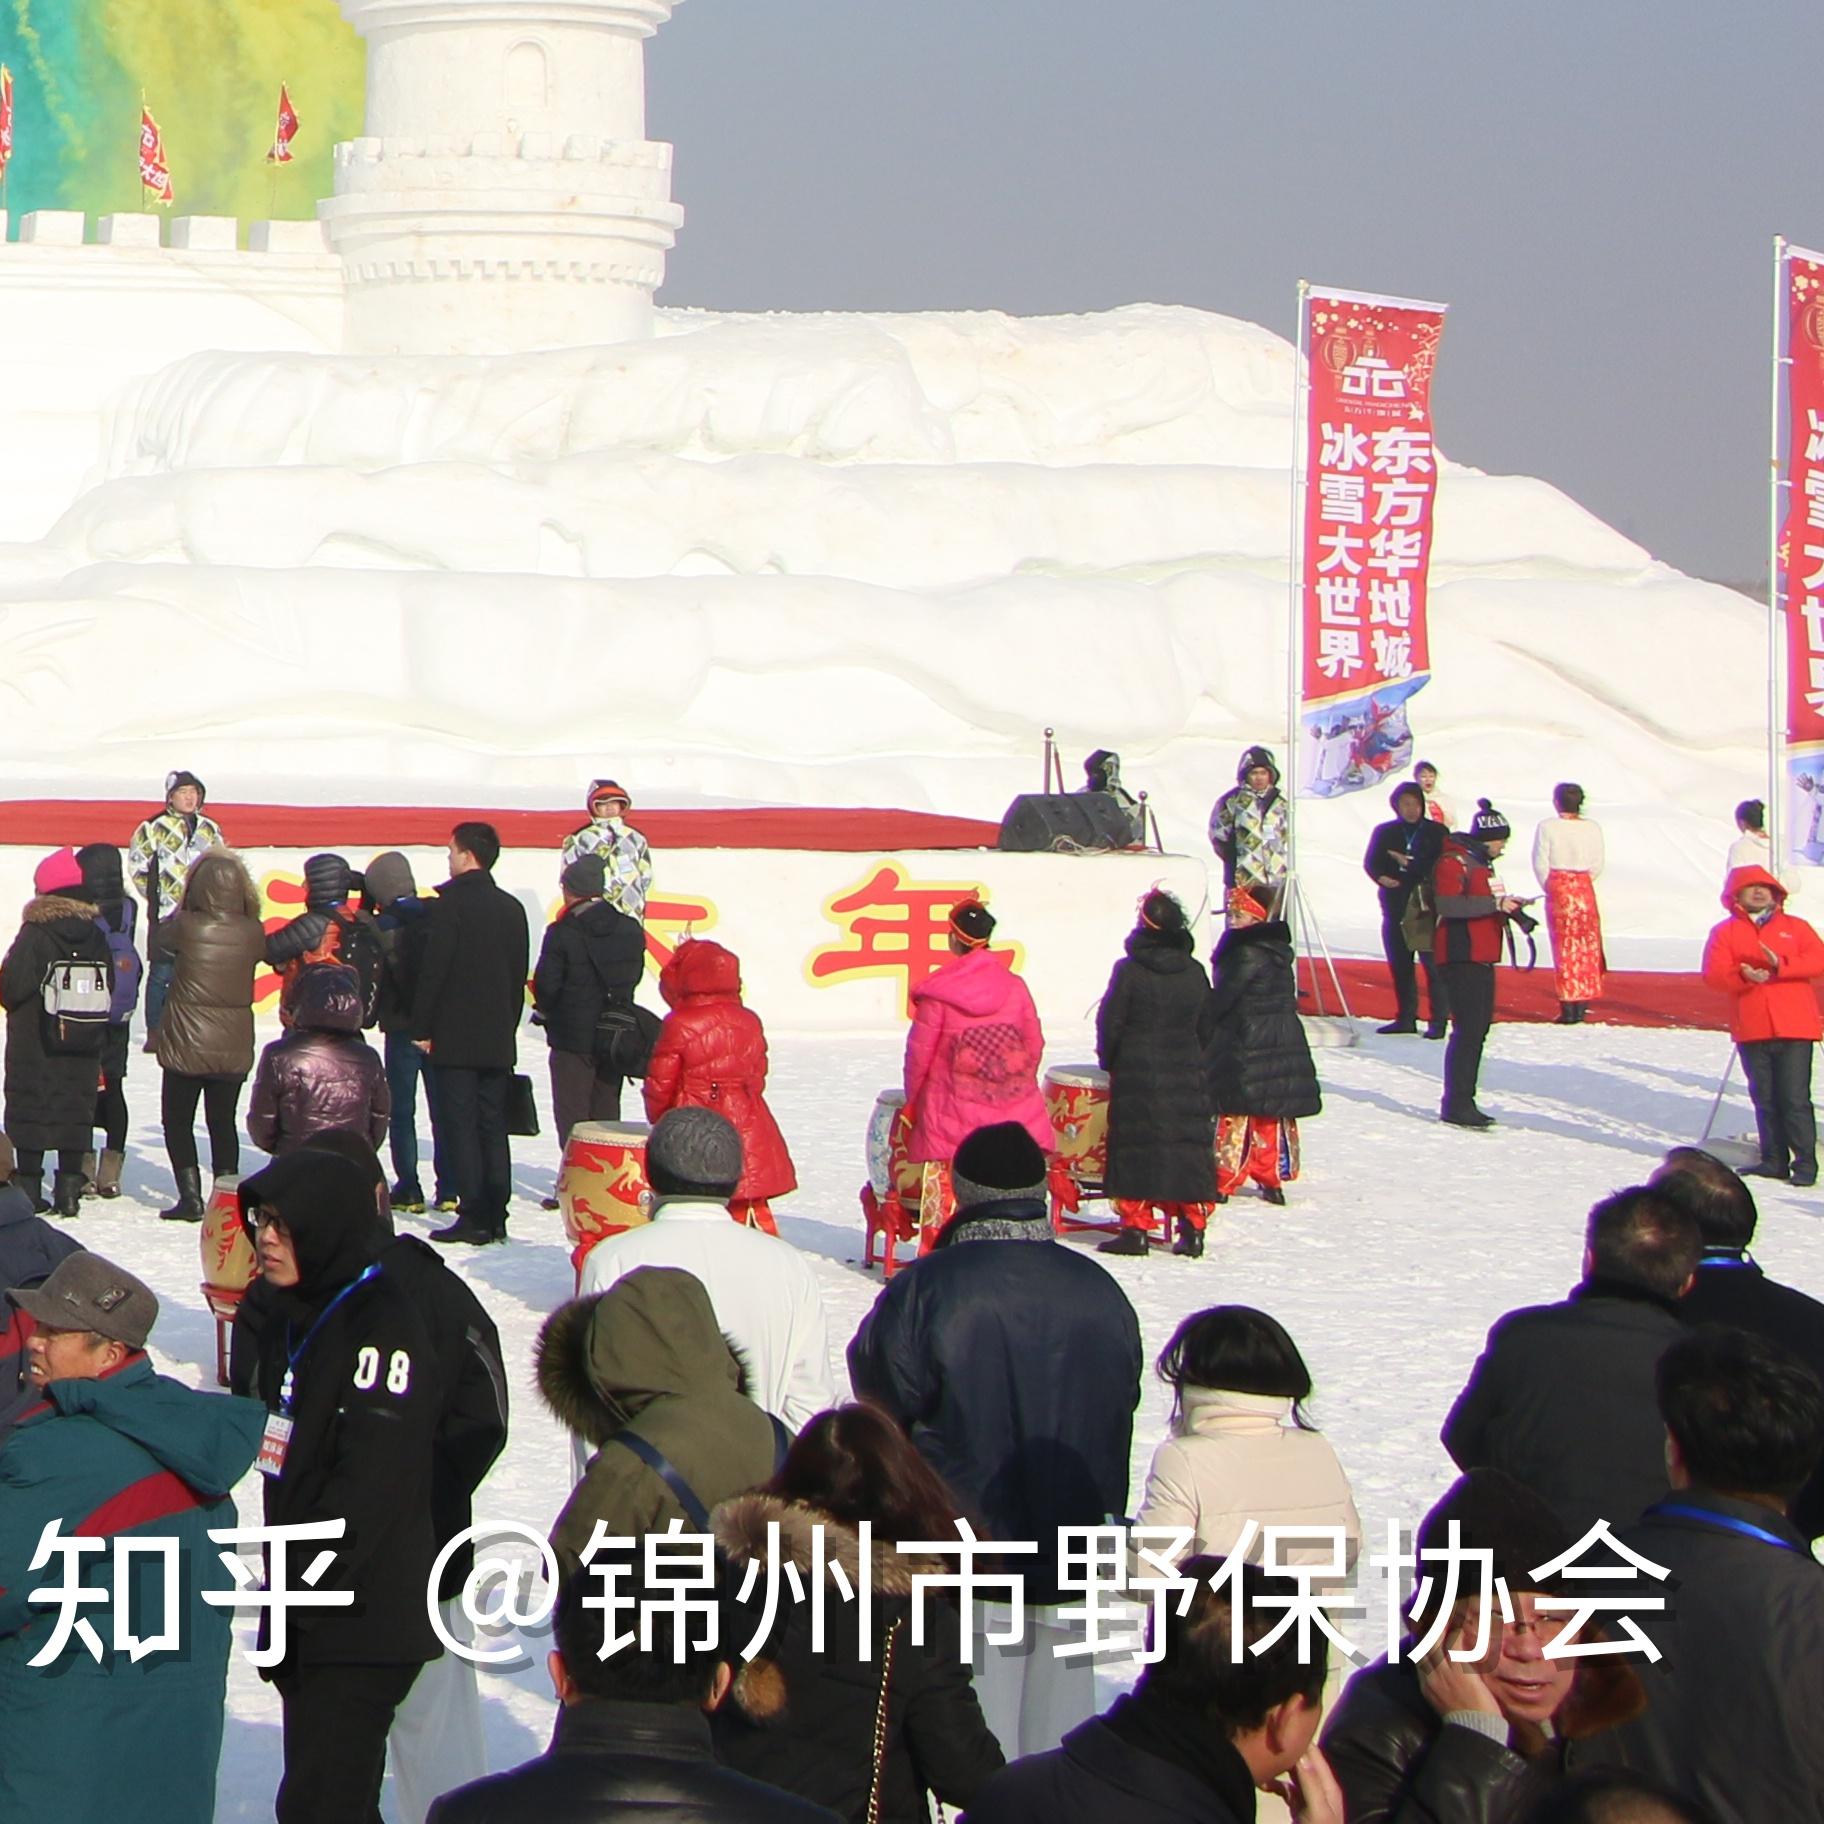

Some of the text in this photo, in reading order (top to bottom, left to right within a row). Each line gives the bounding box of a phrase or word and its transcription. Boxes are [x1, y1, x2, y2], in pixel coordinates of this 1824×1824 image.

[1315, 422, 1370, 679] 冰雪大世界
[1367, 426, 1432, 679] 东方华地城
[354, 1346, 410, 1395] 08
